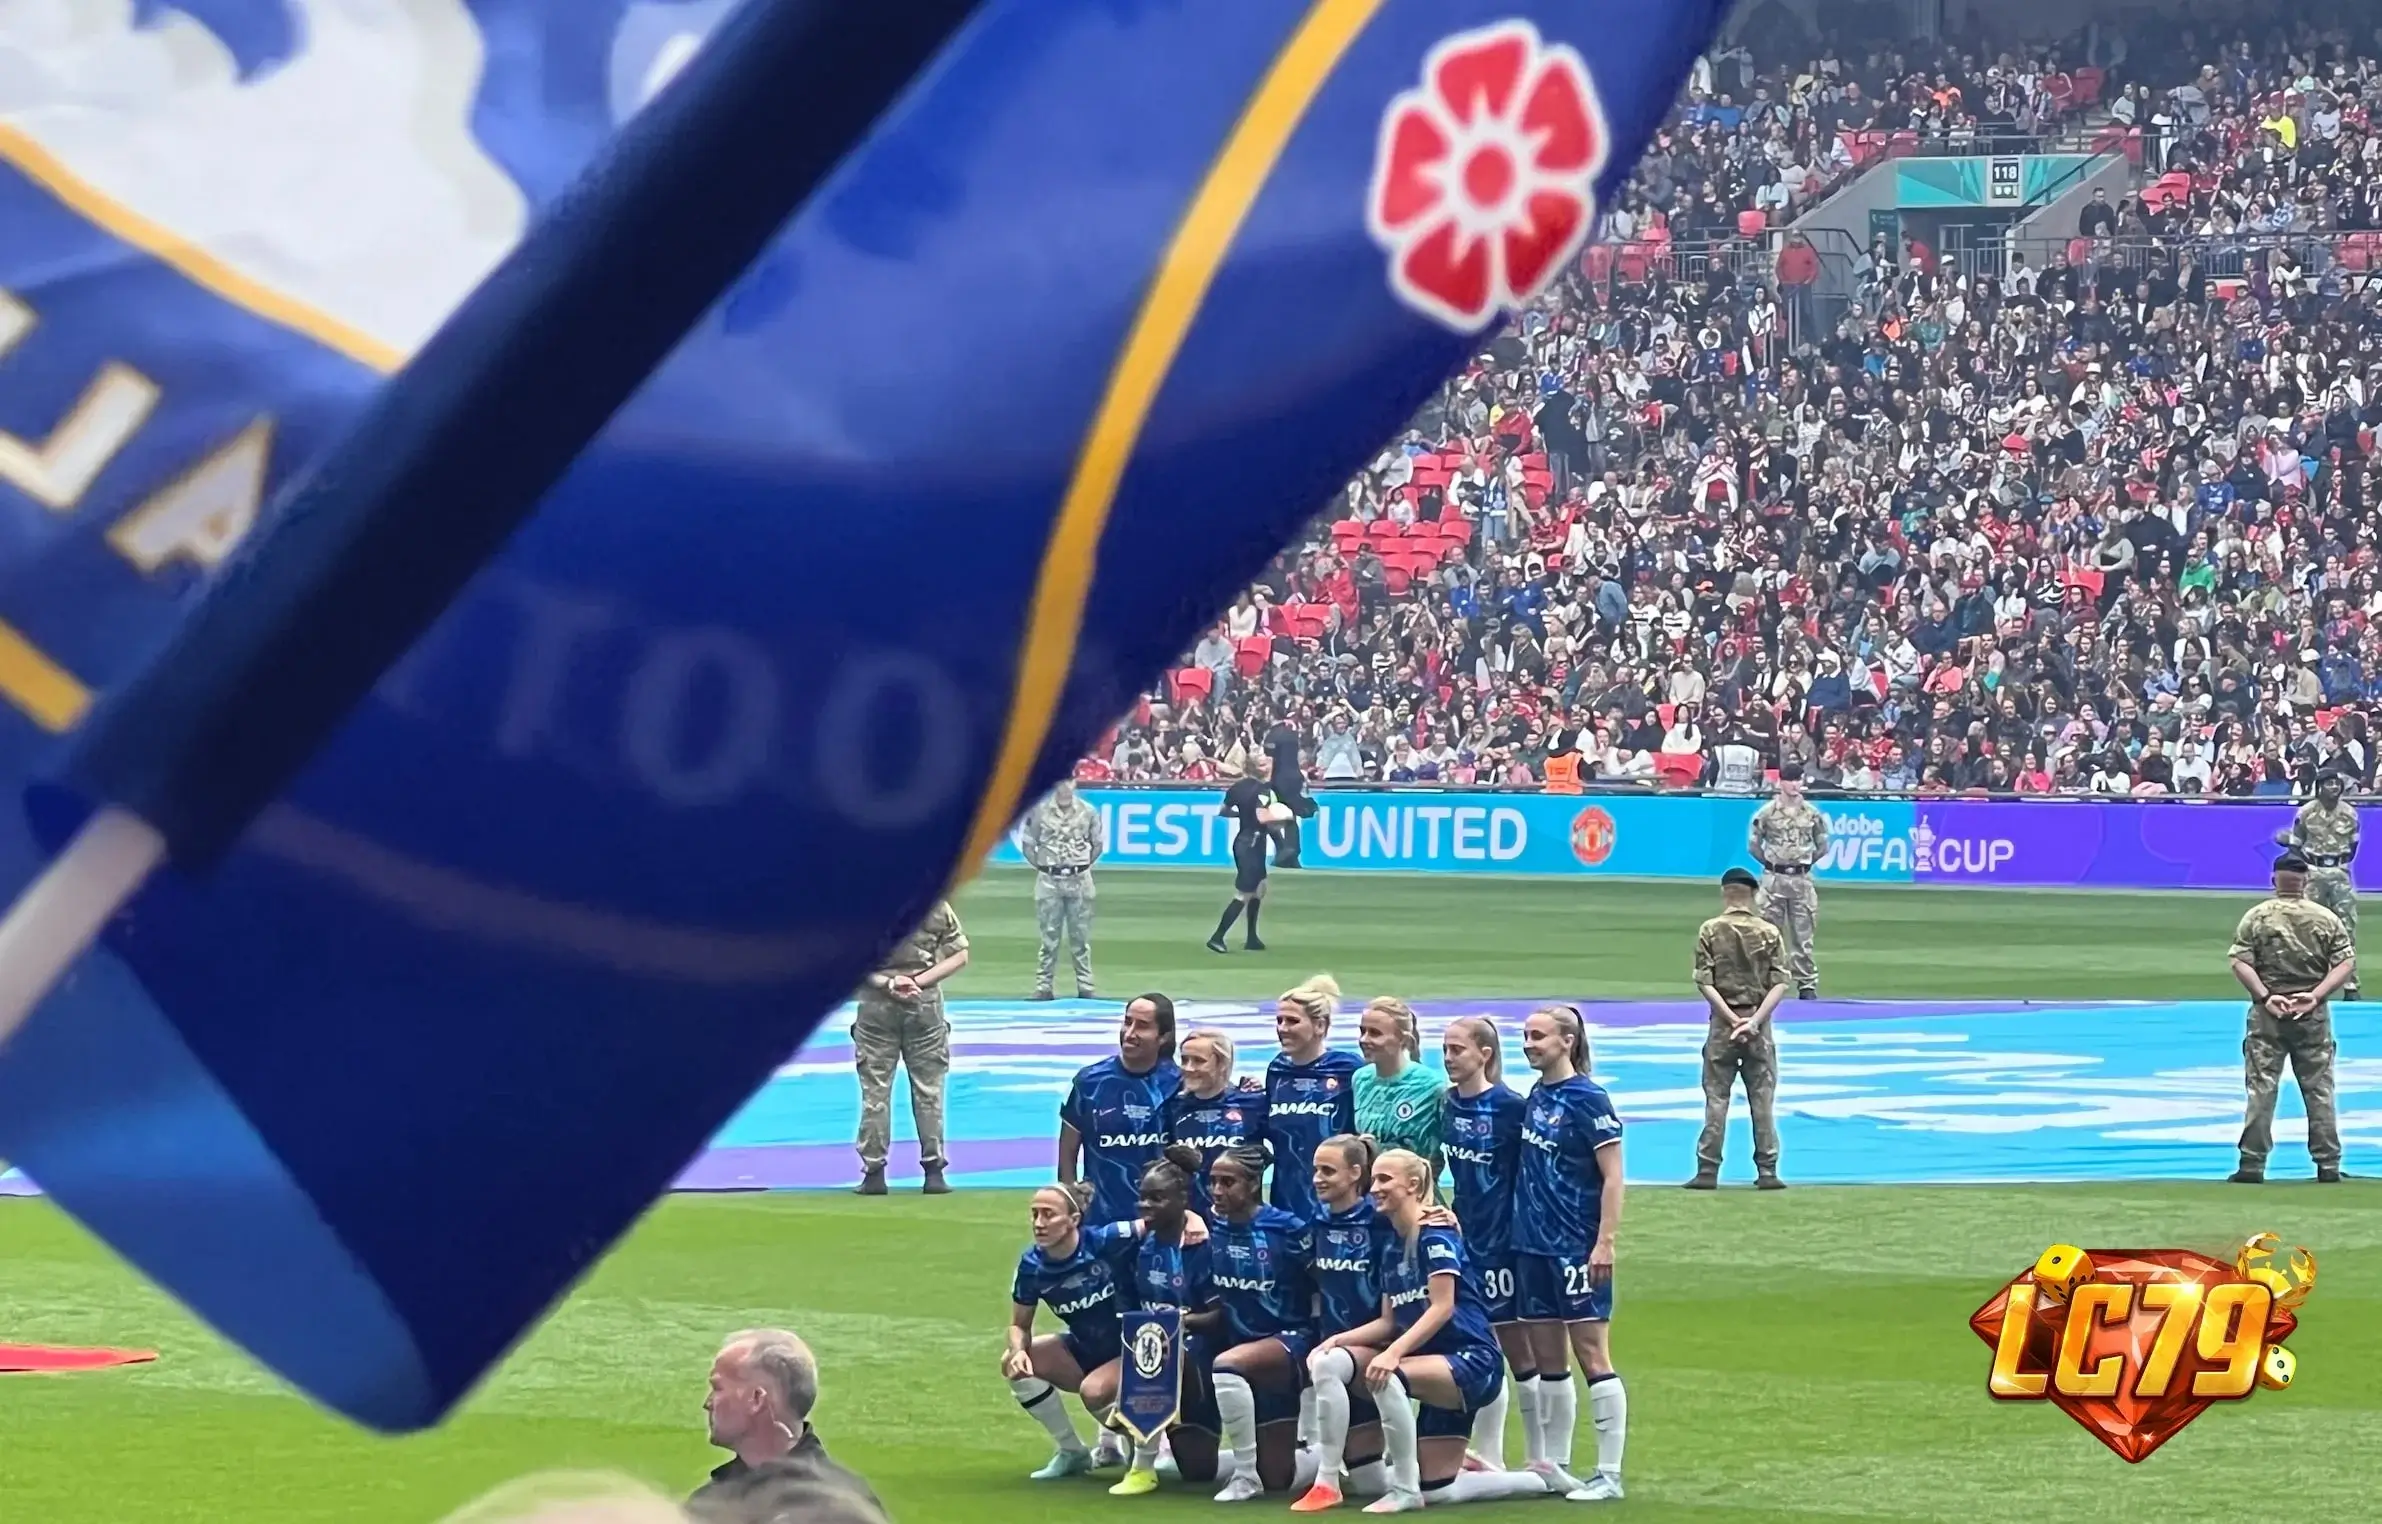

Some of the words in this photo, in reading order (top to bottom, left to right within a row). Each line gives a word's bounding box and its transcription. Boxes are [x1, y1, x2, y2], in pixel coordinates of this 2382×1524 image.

[1994, 165, 2018, 180] 118
[1318, 806, 1528, 860] UNITED
[1822, 813, 1884, 836] Adobe
[1938, 838, 2015, 873] CUP
[1100, 1131, 1169, 1148] DAMAC
[1438, 1141, 1496, 1166] AMAC
[1484, 1267, 1515, 1299] 30
[1564, 1263, 1593, 1296] 21
